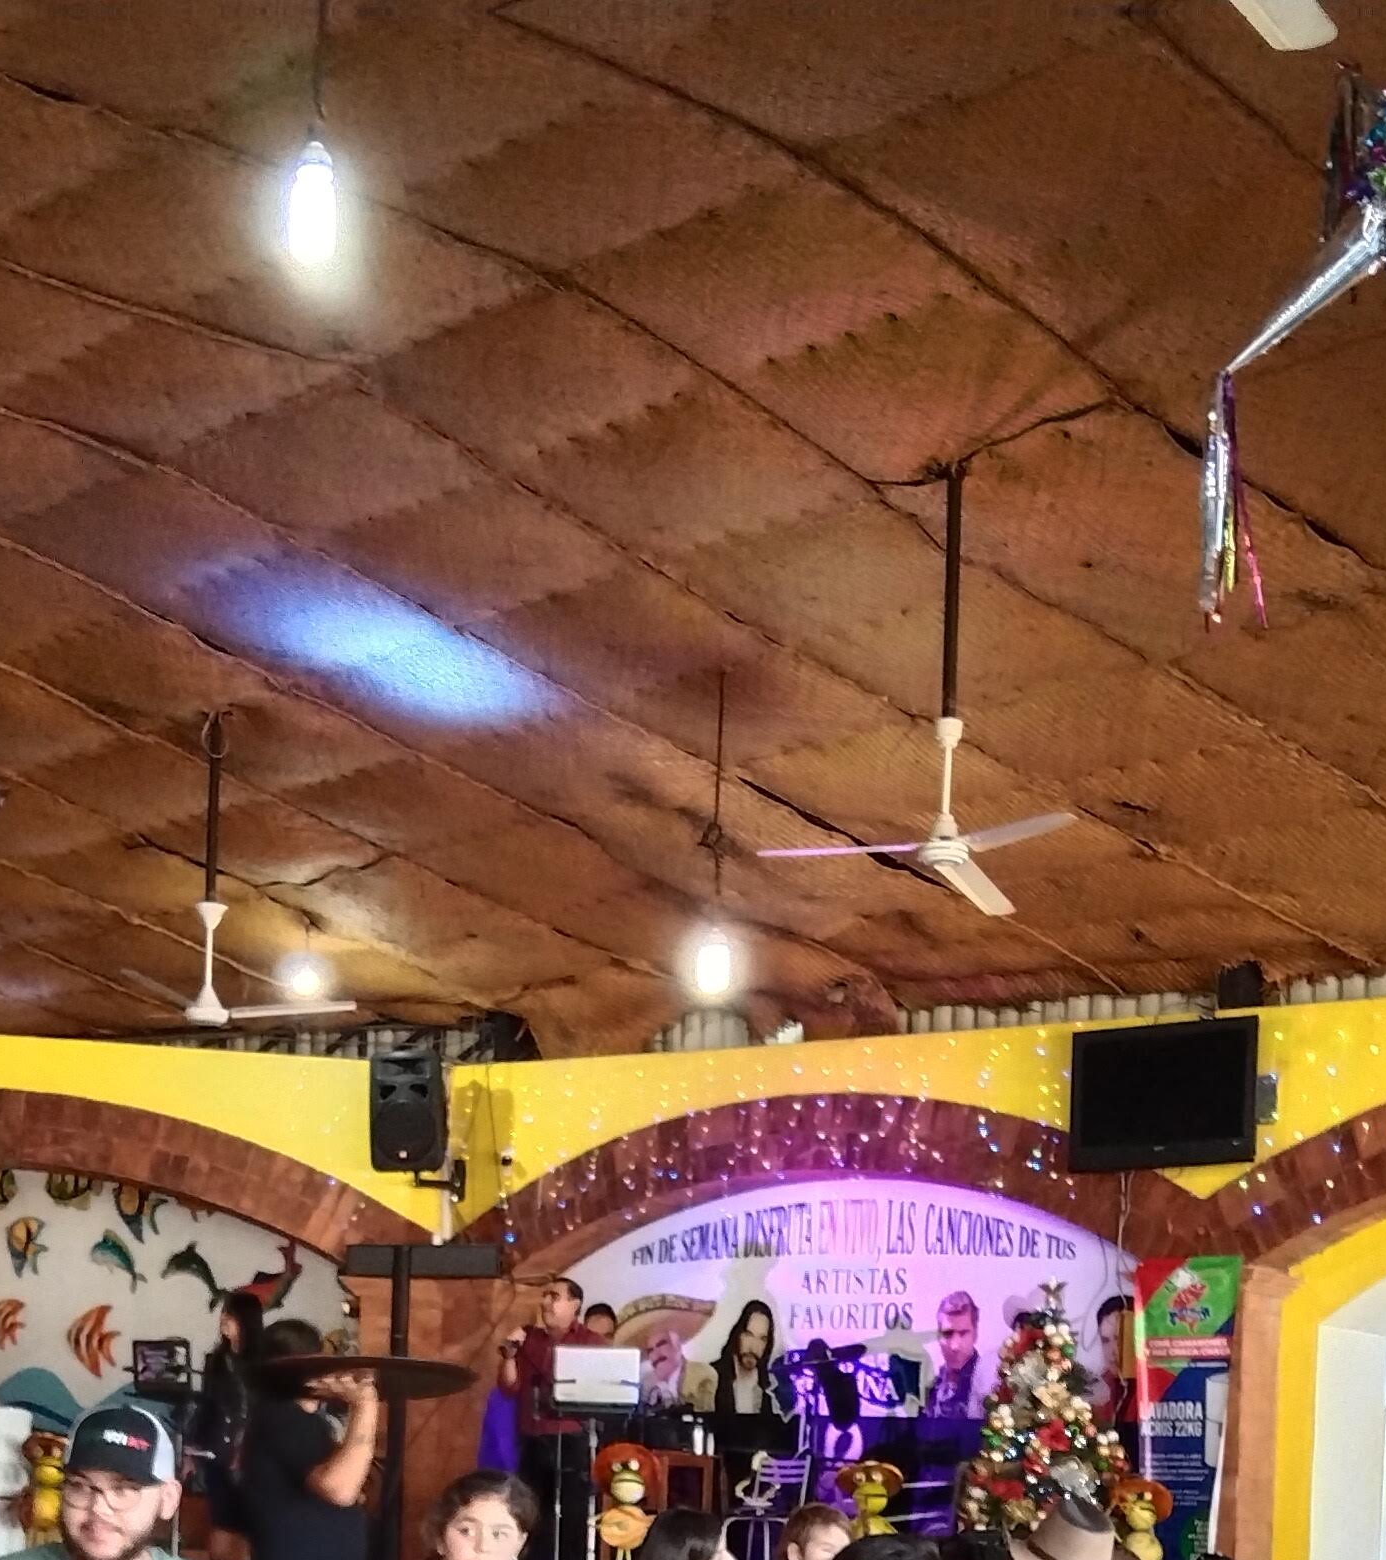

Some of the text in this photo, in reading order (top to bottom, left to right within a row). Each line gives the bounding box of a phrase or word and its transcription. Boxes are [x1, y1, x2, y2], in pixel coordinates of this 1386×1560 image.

[631, 1240, 655, 1266] FIN
[658, 1233, 678, 1264] DE
[680, 1213, 740, 1260] SEMANA
[743, 1202, 814, 1258] DISFRUTA
[819, 1200, 841, 1255] EN
[886, 1199, 916, 1255] LAS
[925, 1203, 1014, 1258] CANCIONES
[1018, 1224, 1041, 1258] DE
[1045, 1232, 1077, 1260] TUS
[801, 1267, 908, 1295] ARTISTAS
[789, 1301, 913, 1331] FAVORITOS
